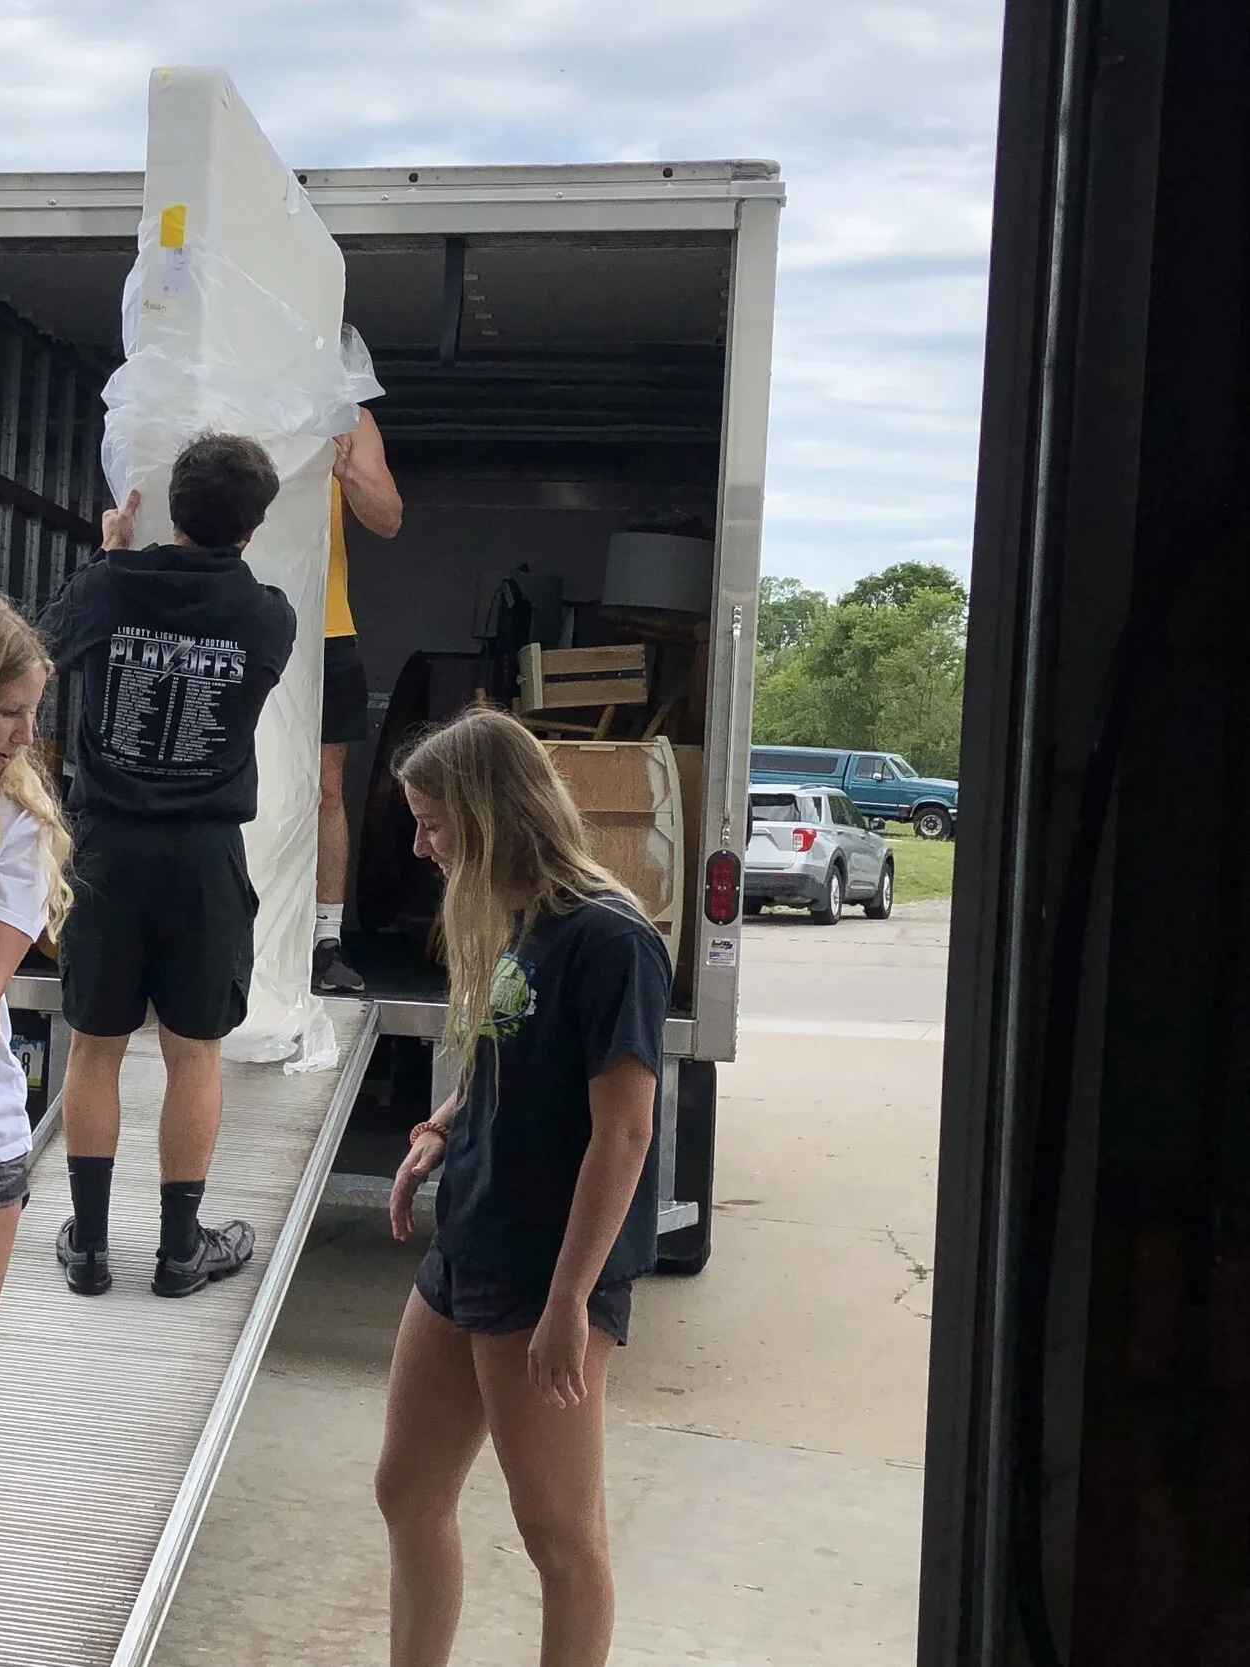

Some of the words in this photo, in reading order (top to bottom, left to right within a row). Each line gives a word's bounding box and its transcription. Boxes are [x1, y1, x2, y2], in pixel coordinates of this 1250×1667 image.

[117, 626, 151, 637] LIBERTY
[200, 638, 239, 650] FOOTBALL
[109, 637, 247, 680] PLAYOFFS
